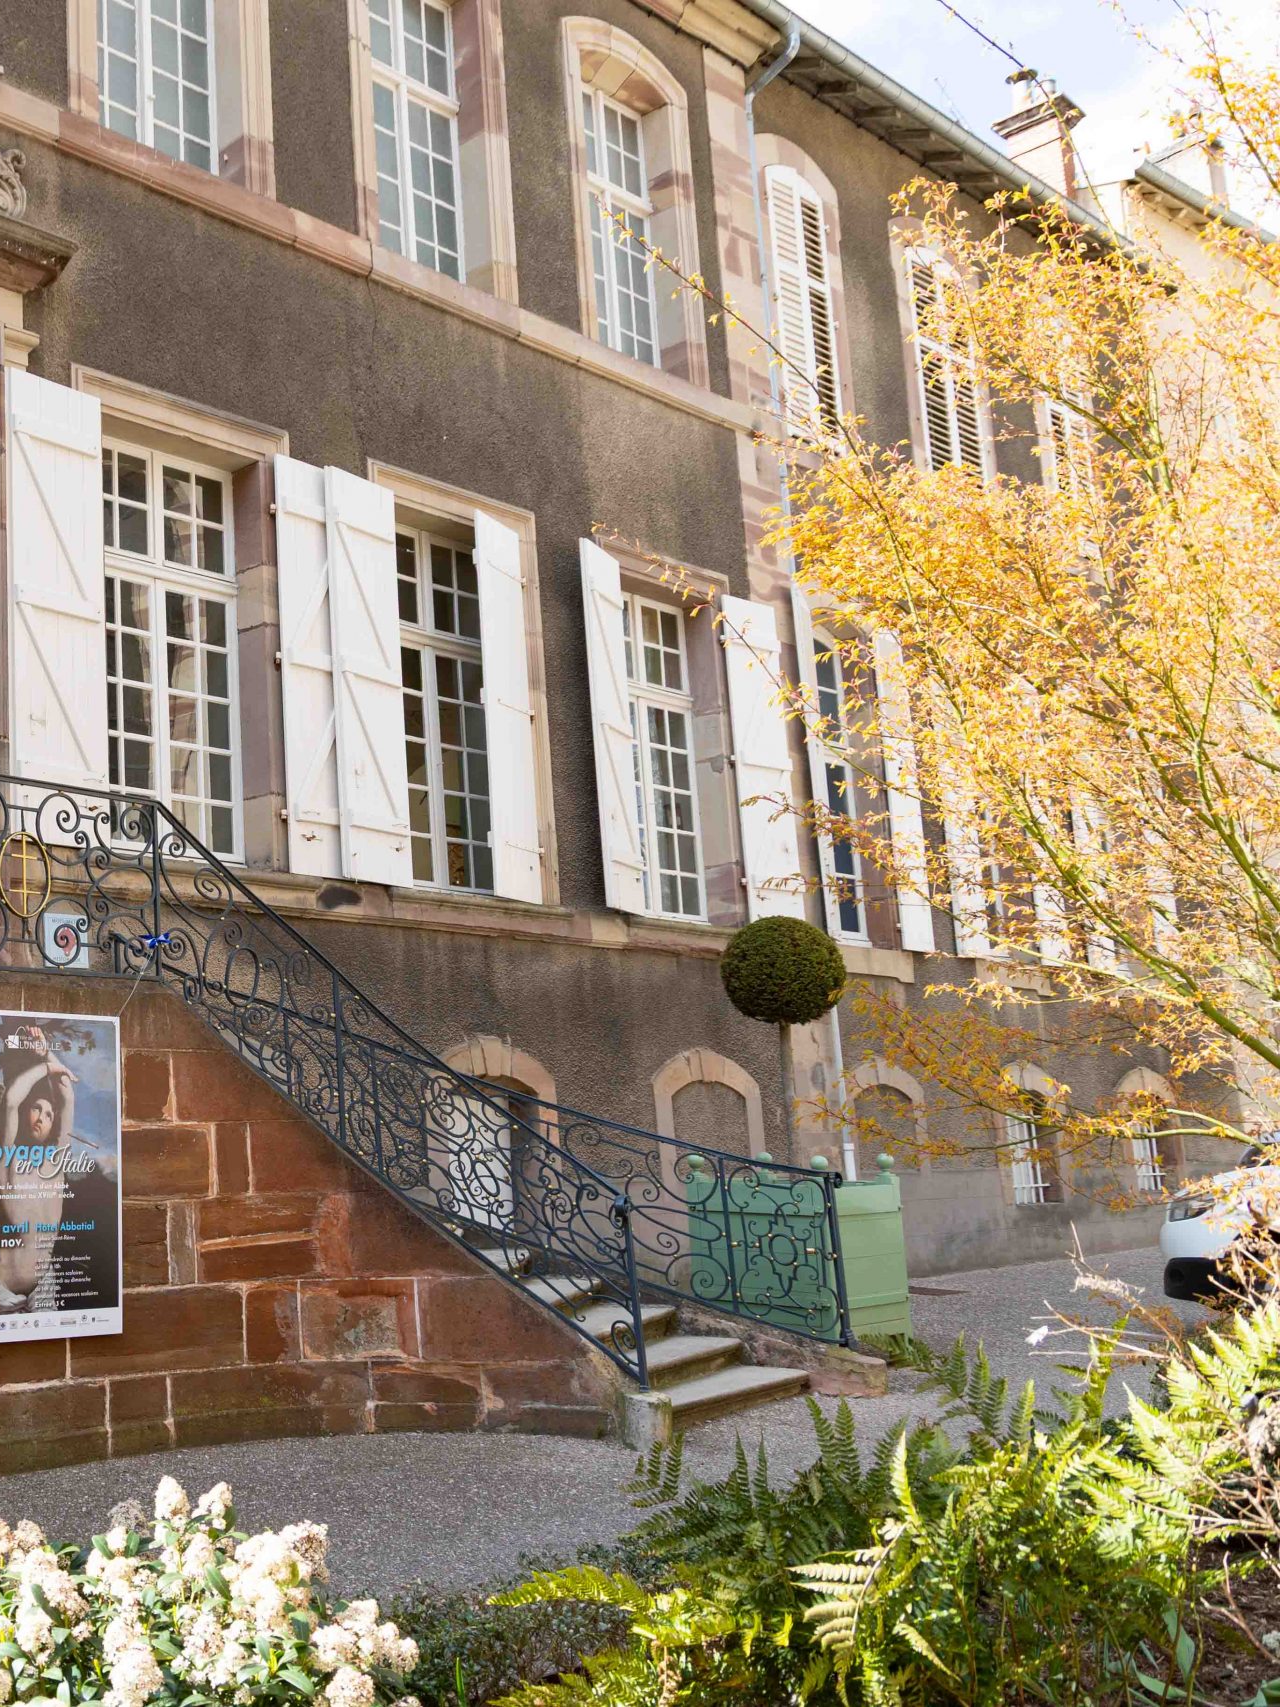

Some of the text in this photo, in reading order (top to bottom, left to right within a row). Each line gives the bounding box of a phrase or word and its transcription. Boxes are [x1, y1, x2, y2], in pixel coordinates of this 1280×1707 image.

[15, 1143, 96, 1179] en Italie
[2, 1220, 29, 1234] avril
[59, 1219, 95, 1231] Abbatial
[0, 1238, 25, 1249] nov.
